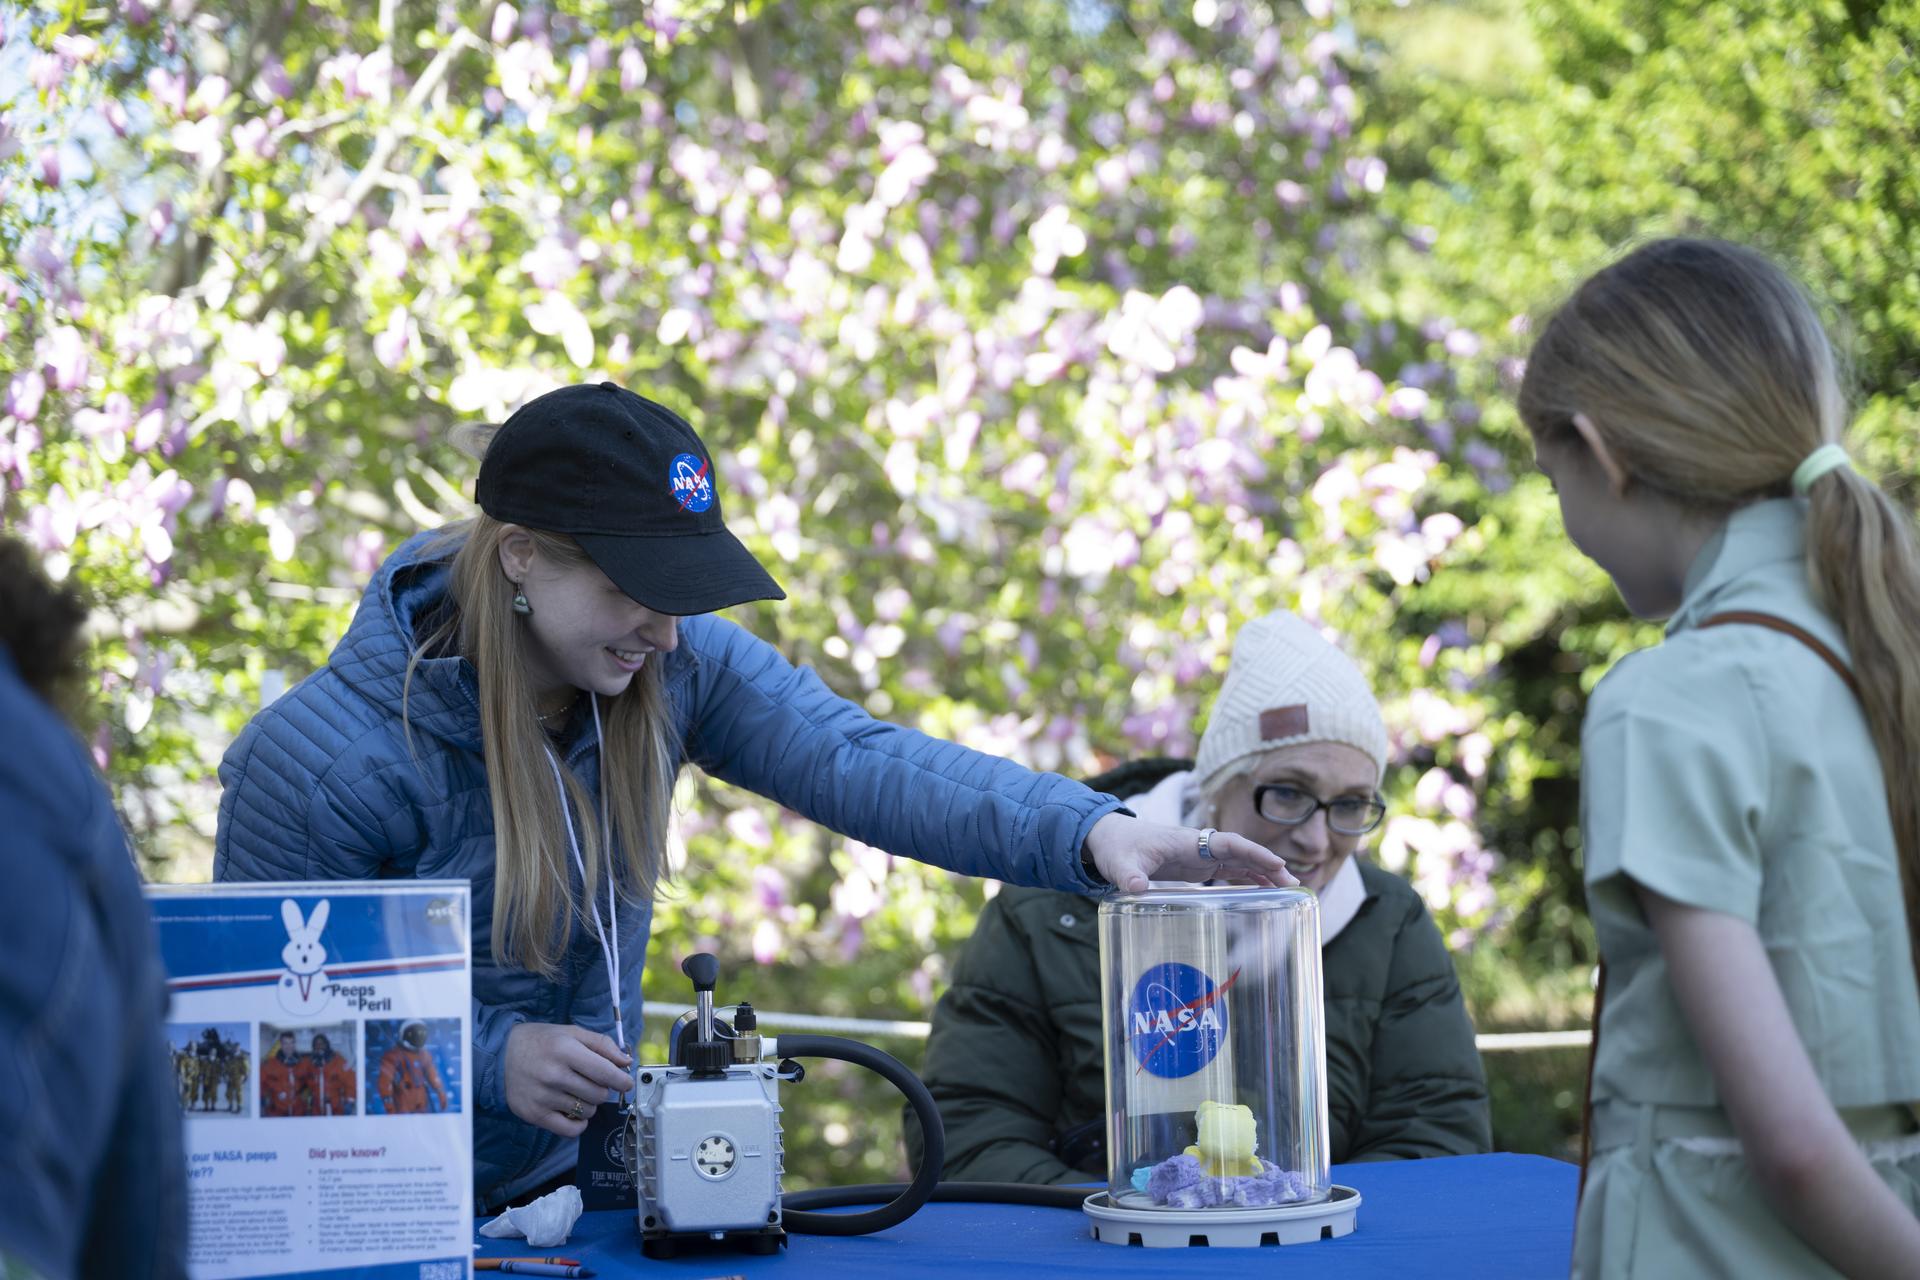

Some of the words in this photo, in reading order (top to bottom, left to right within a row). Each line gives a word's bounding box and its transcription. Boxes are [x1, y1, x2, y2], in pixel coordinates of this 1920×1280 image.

[672, 475, 710, 491] NASA
[321, 984, 376, 1000] Peeps
[359, 997, 392, 1012] Peril
[1134, 1007, 1222, 1035] NASA
[191, 1152, 211, 1163] our
[213, 1150, 243, 1161] NASA
[245, 1151, 278, 1163] peeps
[308, 1147, 327, 1159] Did
[330, 1149, 349, 1161] you
[351, 1146, 387, 1158] know?
[186, 1166, 214, 1178] ve??
[591, 1170, 606, 1180] THE
